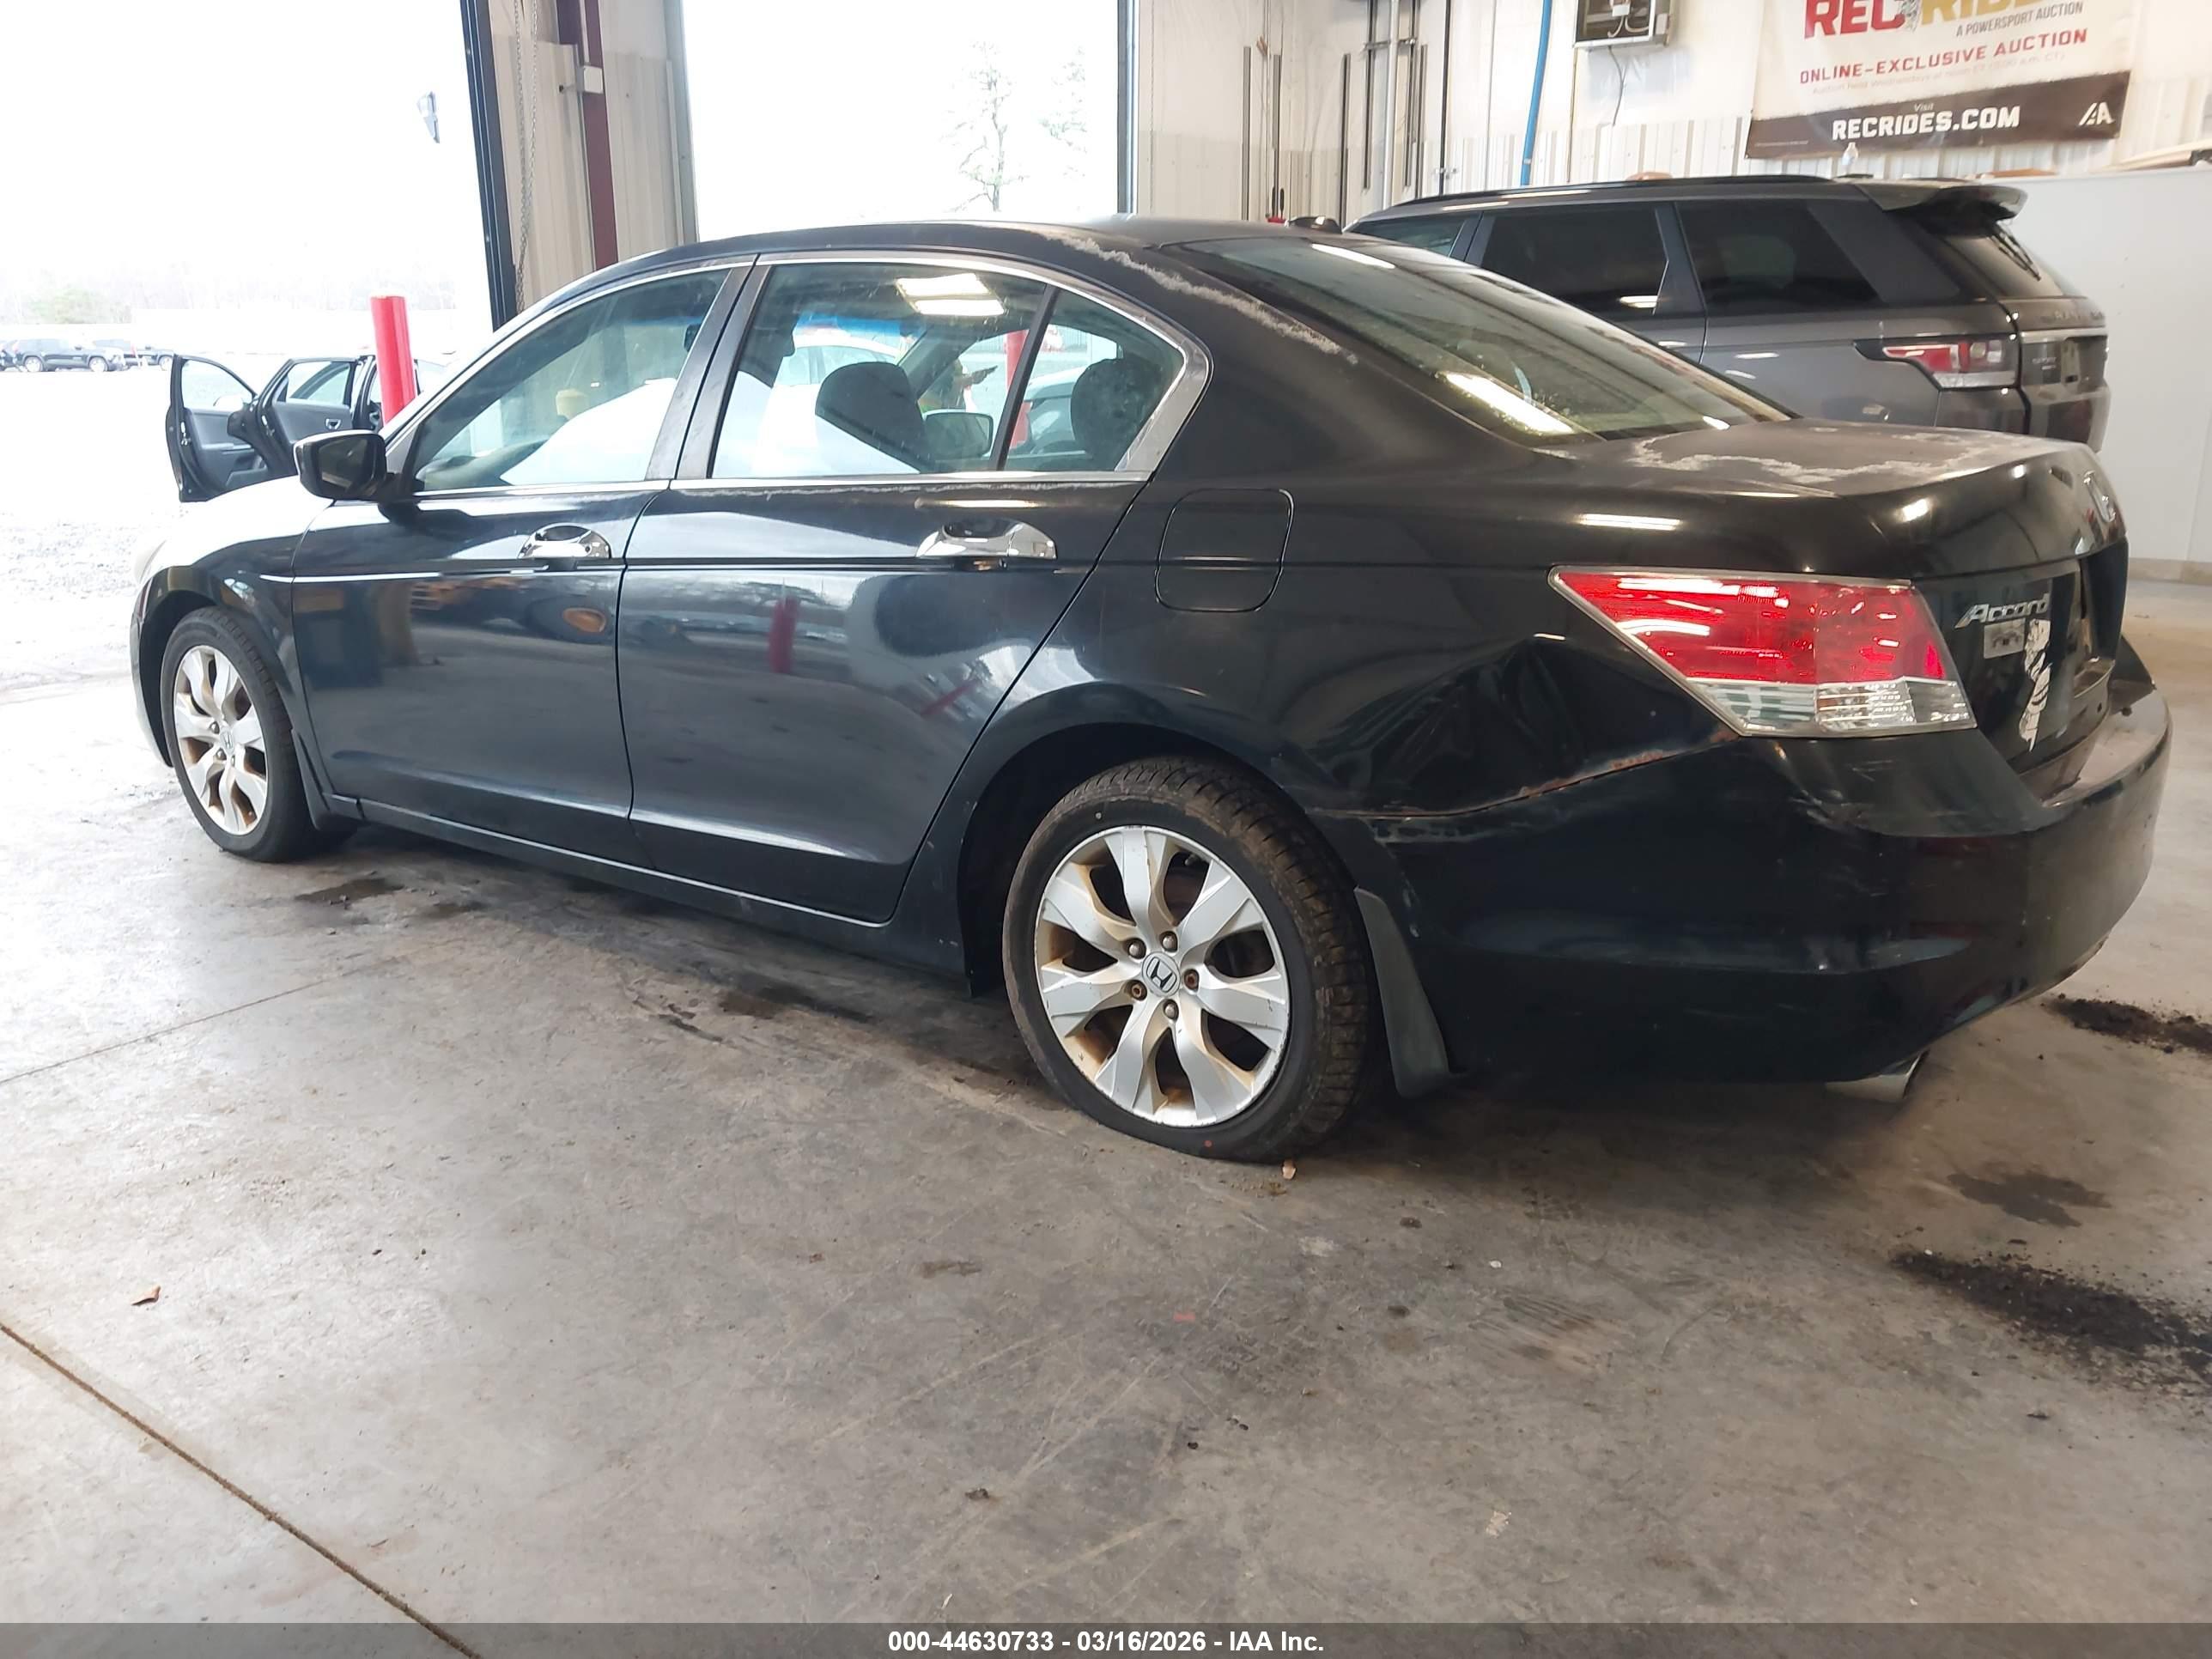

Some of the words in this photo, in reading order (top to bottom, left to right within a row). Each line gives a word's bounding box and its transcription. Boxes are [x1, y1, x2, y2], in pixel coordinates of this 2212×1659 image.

[1956, 25, 1964, 38] A
[1966, 12, 2033, 35] POWERSPORT
[2035, 1, 2084, 20] AUCTION
[1799, 45, 1987, 84] ONLINE-EXCLUSIVE
[1993, 27, 2087, 58] AUCTION
[1832, 105, 2021, 141] RECRIDES.COM
[1954, 592, 2051, 629] Accord
